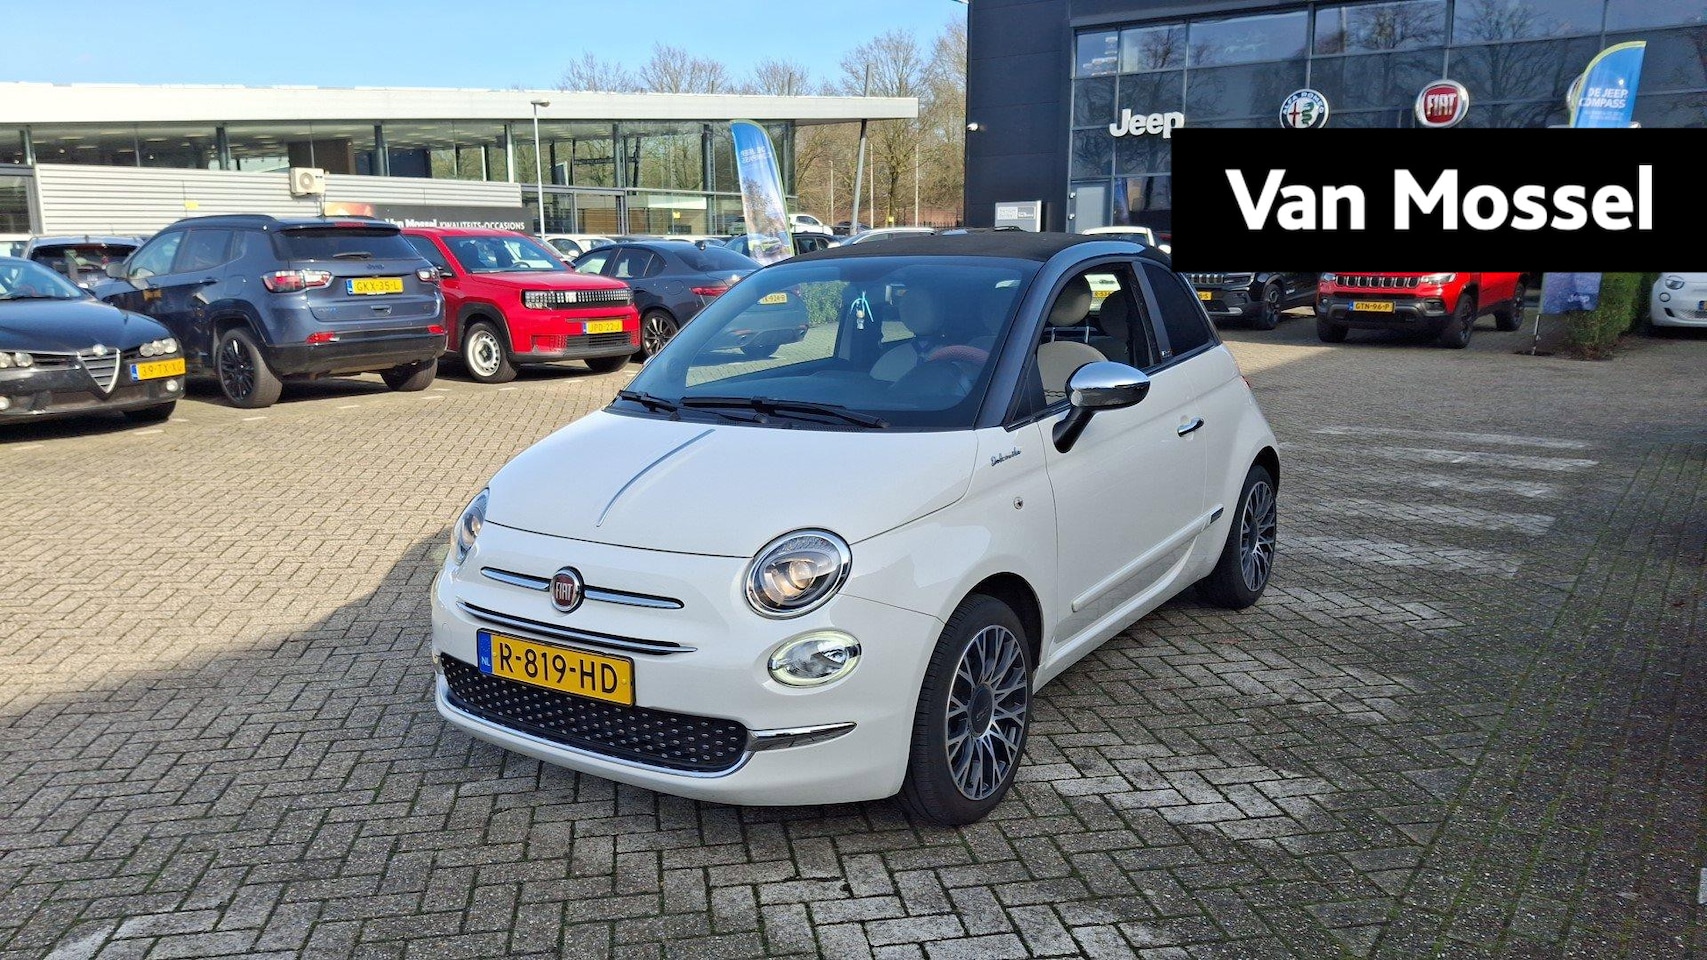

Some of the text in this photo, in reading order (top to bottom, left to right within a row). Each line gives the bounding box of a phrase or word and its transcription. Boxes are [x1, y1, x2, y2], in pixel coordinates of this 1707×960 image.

[1301, 92, 1325, 114] ROMEO
[1427, 93, 1457, 116] FIAT
[1579, 98, 1626, 109] COMPASS
[1109, 108, 1185, 138] Jeep
[356, 280, 399, 292] GKX-35-L
[1355, 302, 1390, 311] GTN-96-P
[555, 581, 573, 600] FIAT
[481, 642, 618, 694] NL R-819-HD
